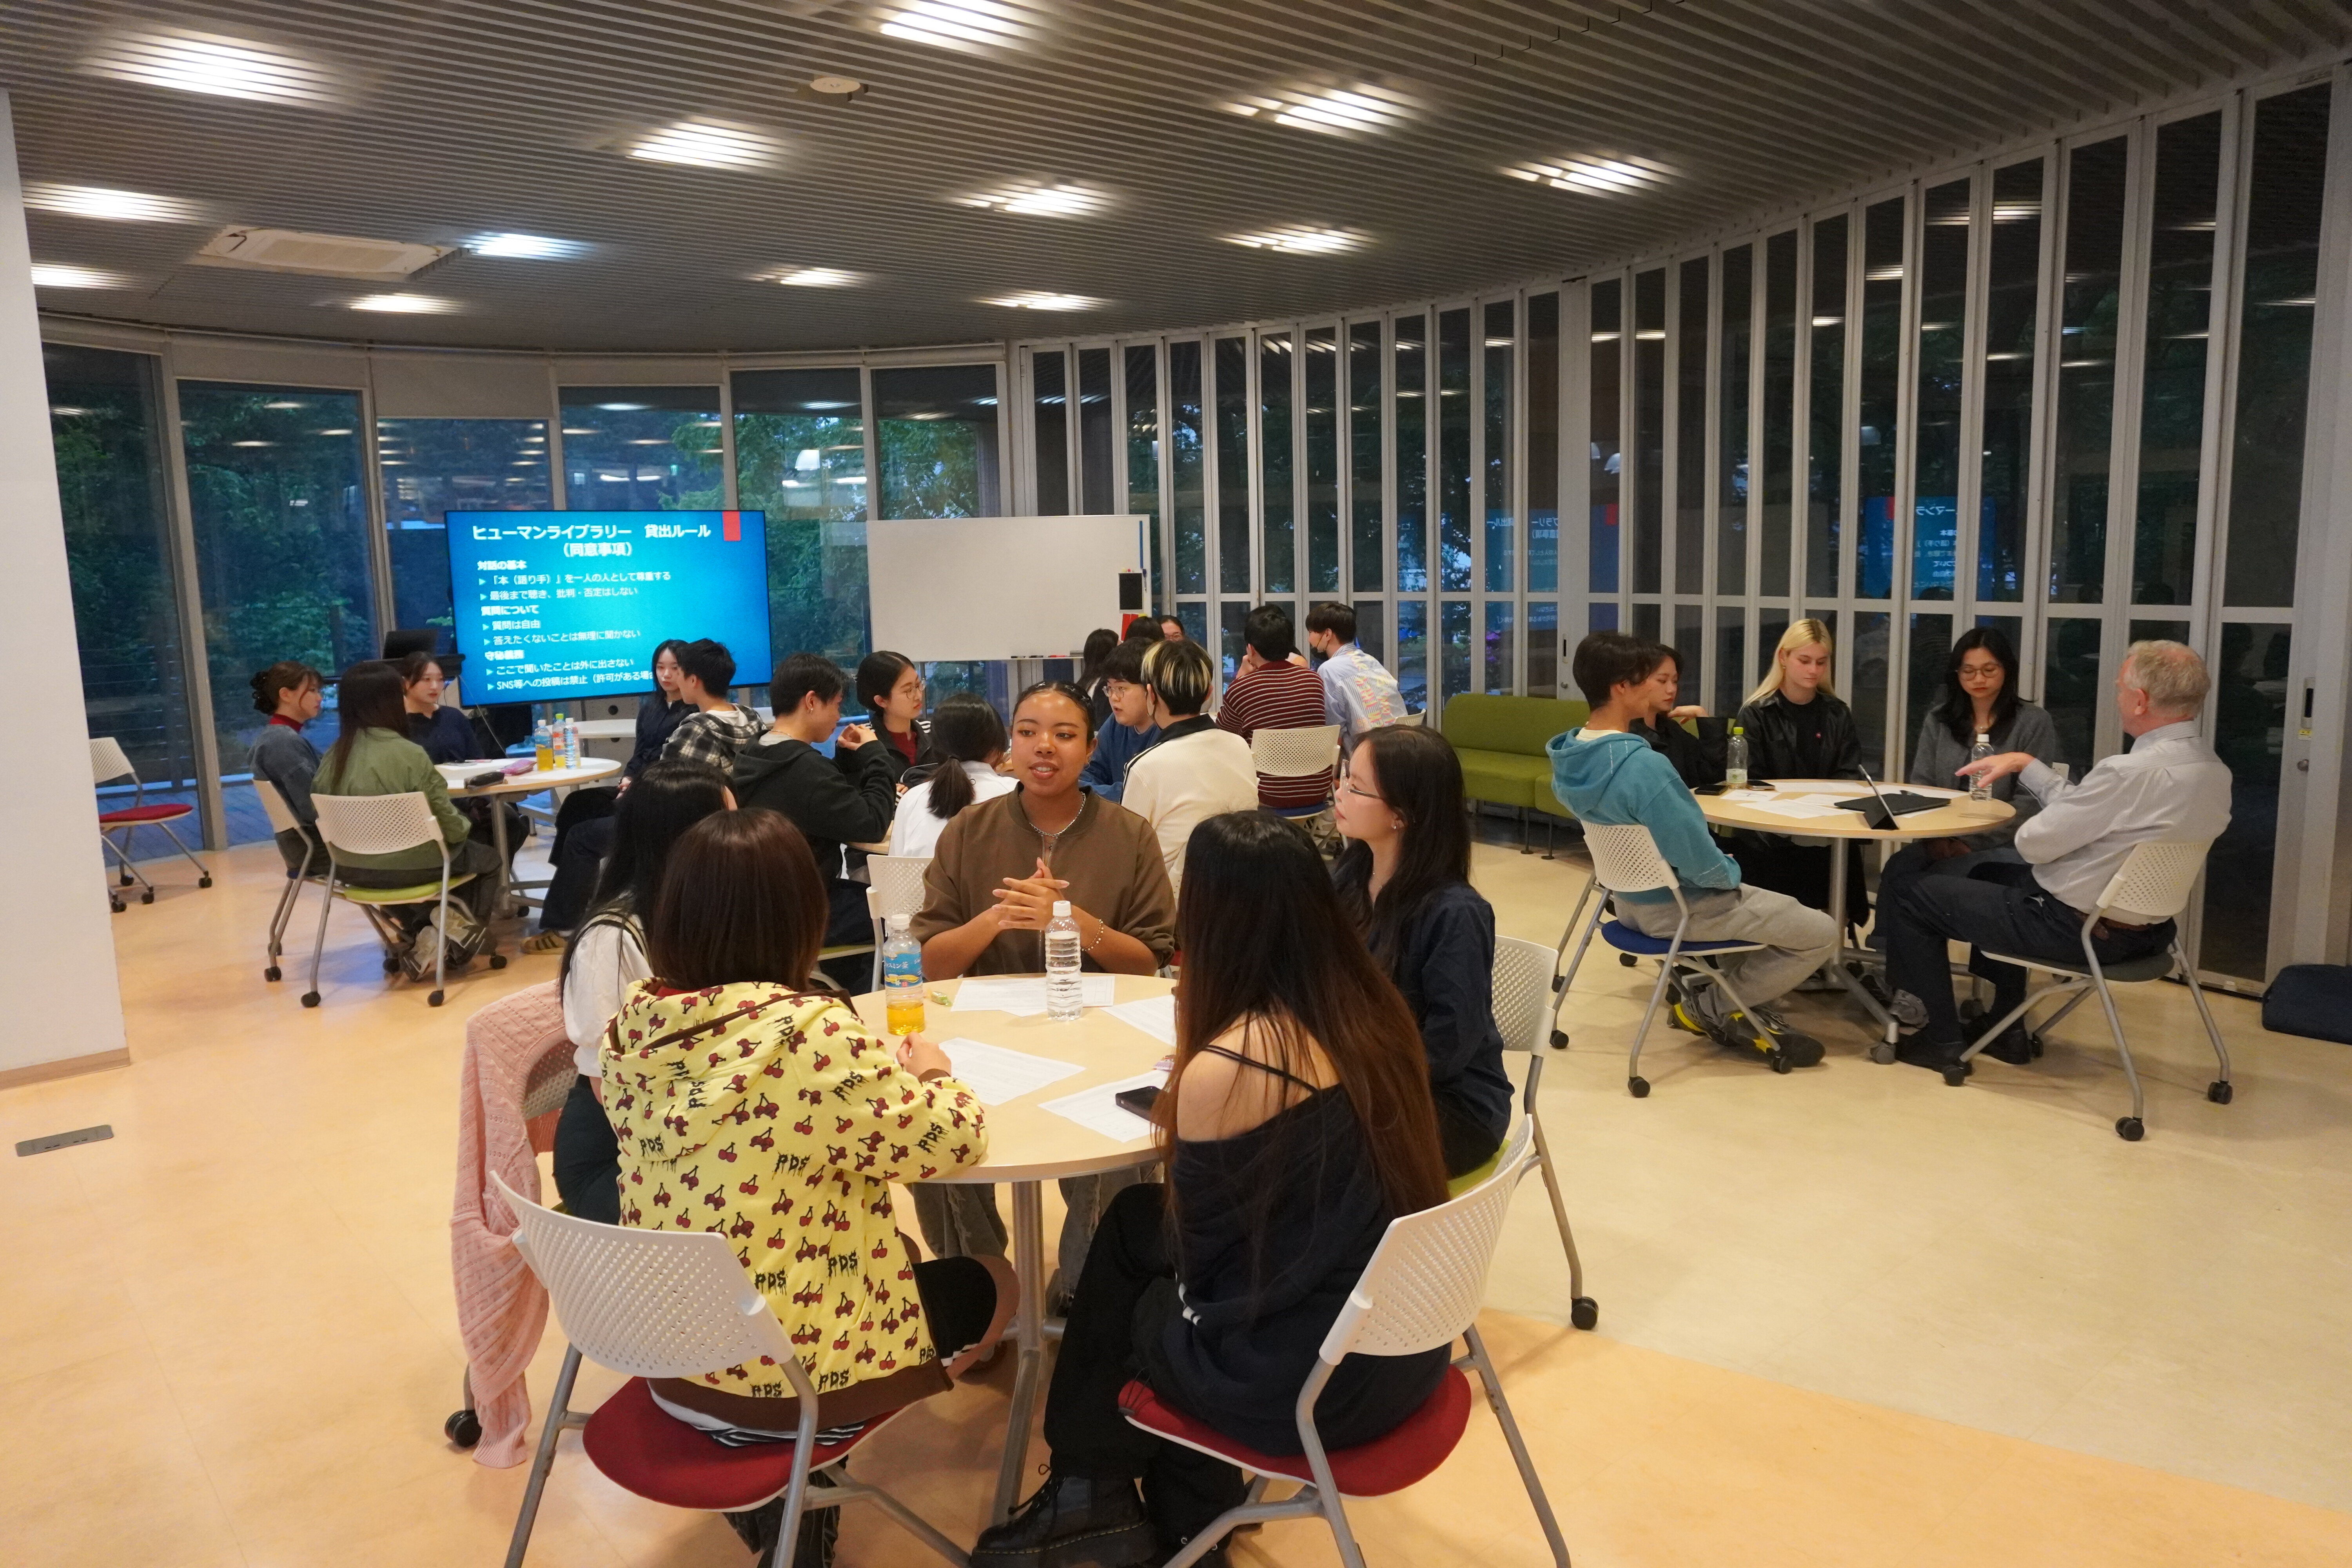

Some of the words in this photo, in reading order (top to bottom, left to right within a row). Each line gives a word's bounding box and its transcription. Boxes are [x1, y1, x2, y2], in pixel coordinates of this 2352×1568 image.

[473, 524, 632, 540] ヒューマンライブラリー
[644, 524, 711, 538] 貸出ルール
[563, 542, 632, 557] （同意事項）
[477, 560, 527, 570] 対話の基本
[481, 605, 539, 616] 質問について
[492, 619, 541, 630] 質問は自由
[493, 630, 641, 645] 答えたくないことは無理に聞かない
[485, 650, 525, 661] 守秘義務
[496, 659, 633, 675] ここで聞いたことは外に出さない
